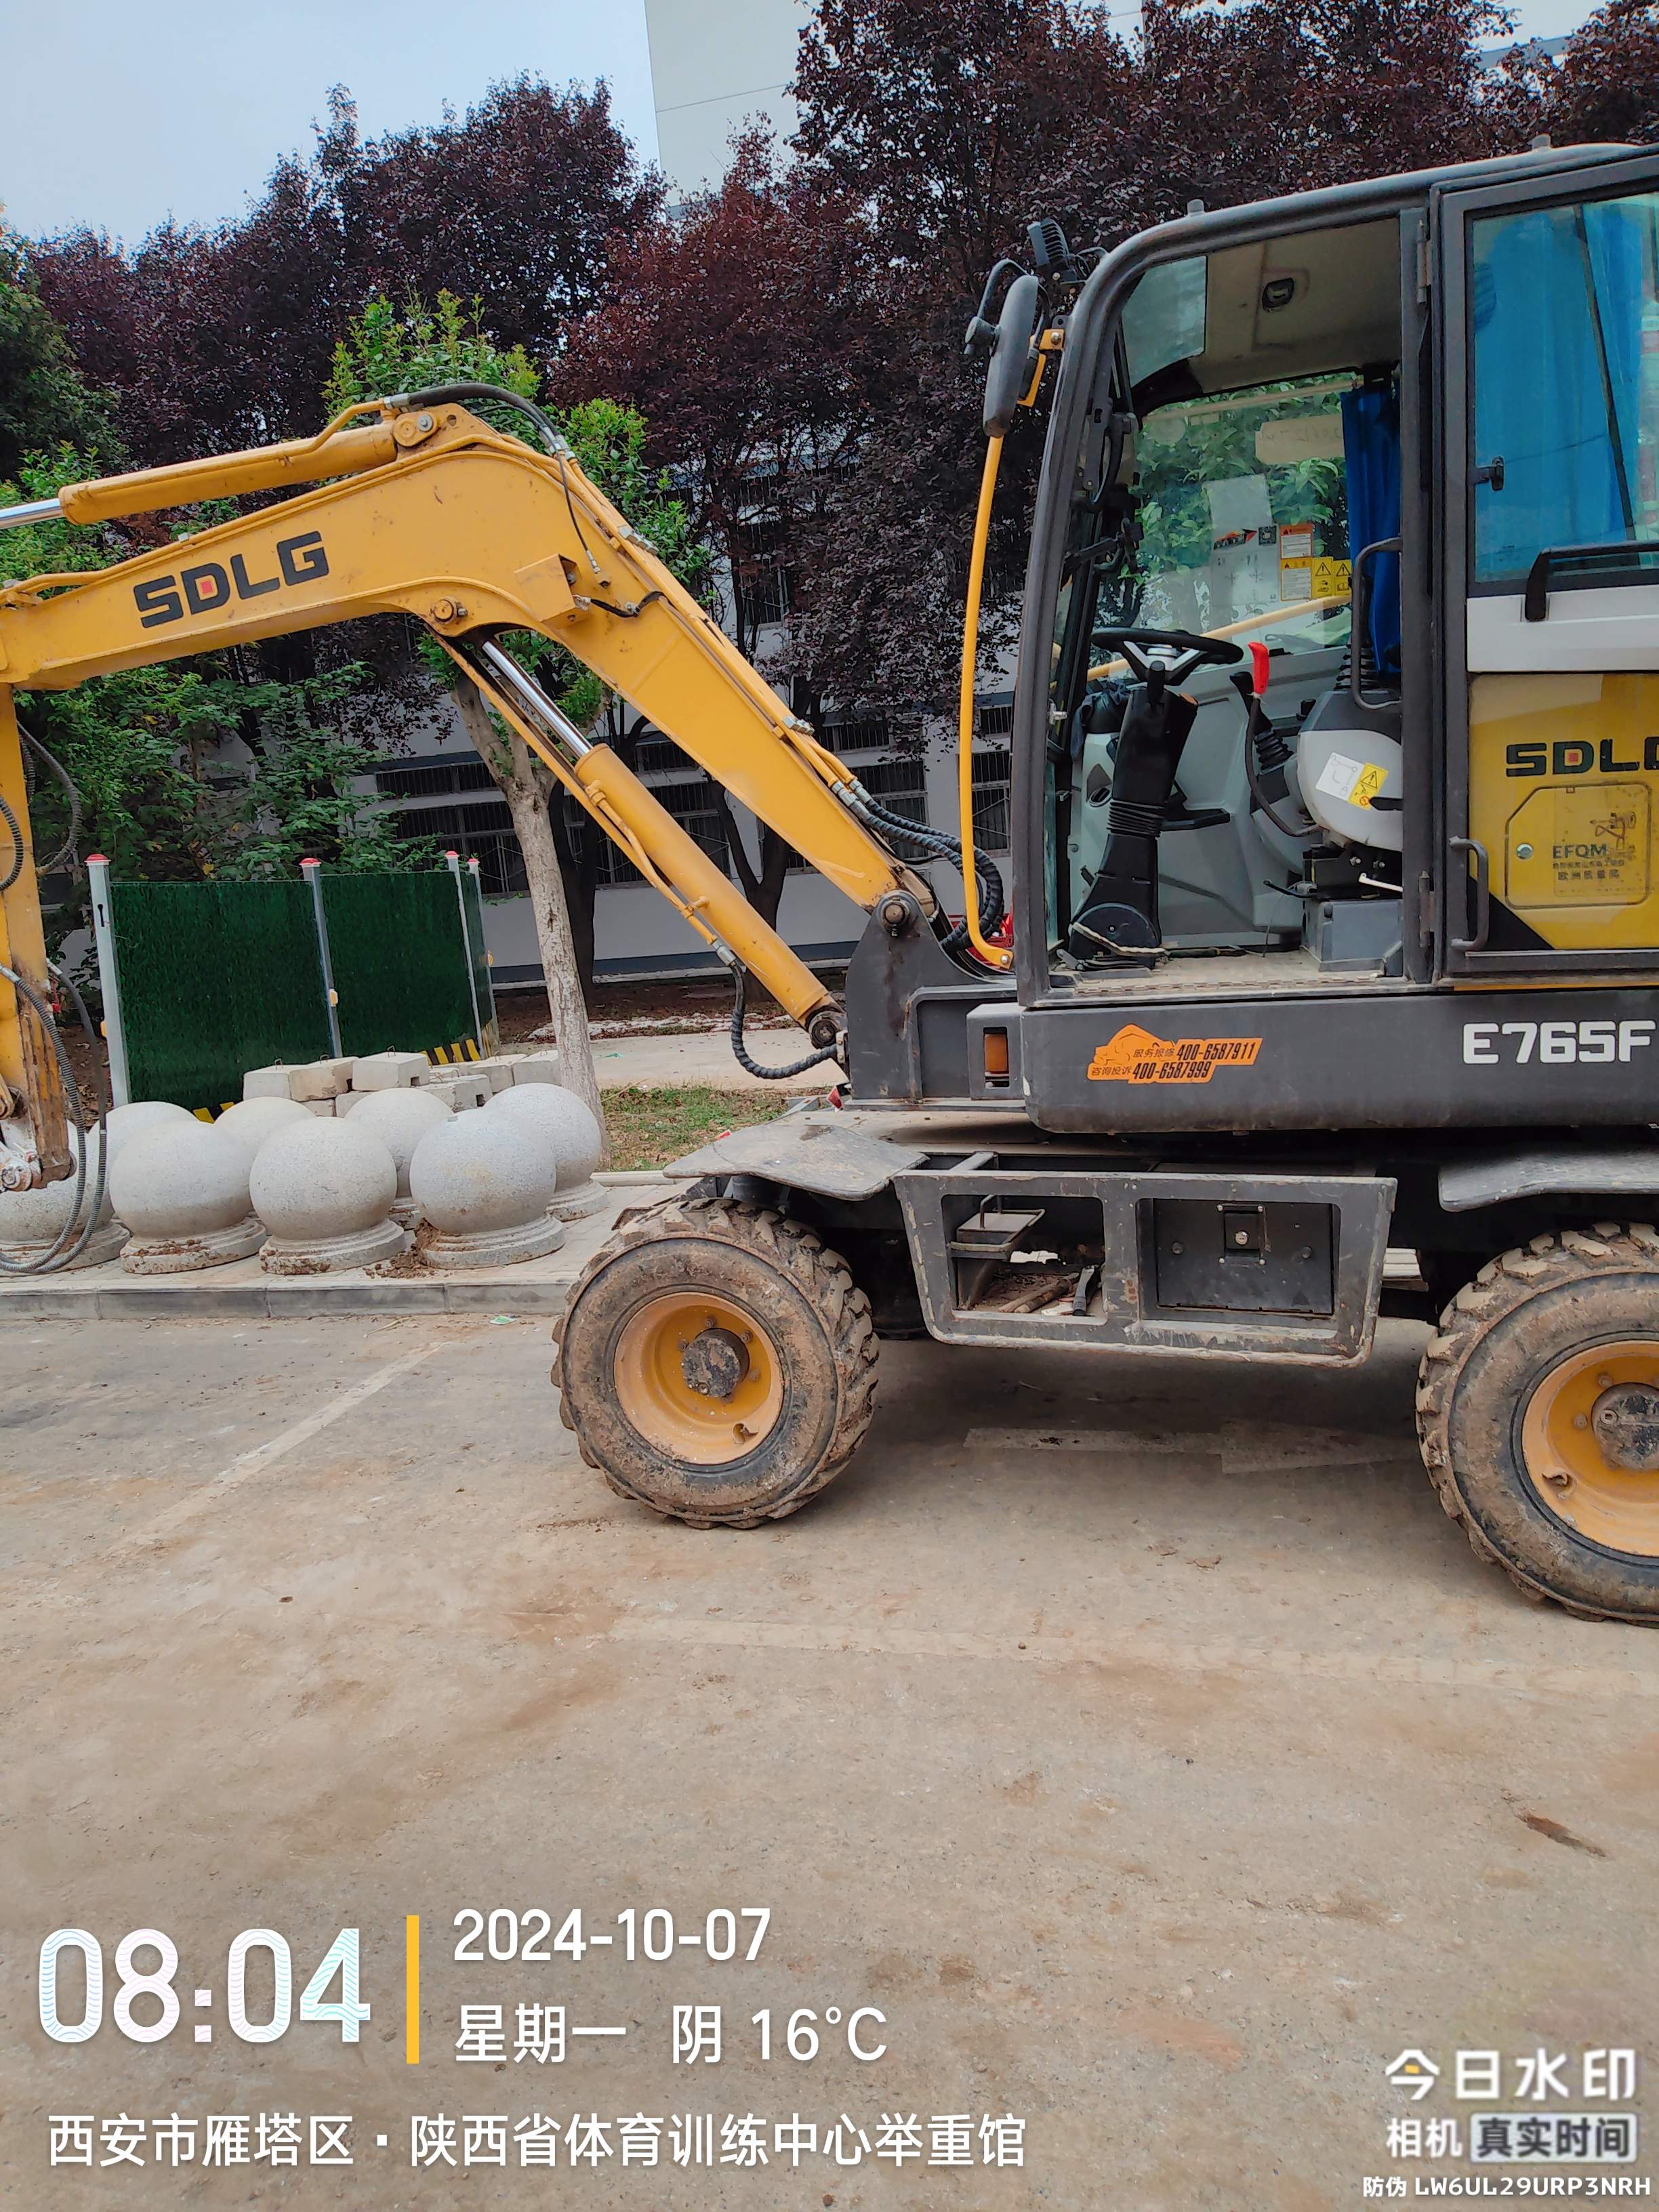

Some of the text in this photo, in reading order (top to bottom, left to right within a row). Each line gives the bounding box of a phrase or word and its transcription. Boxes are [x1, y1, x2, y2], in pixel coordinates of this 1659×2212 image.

[134, 531, 329, 629] SDLG
[1553, 844, 1607, 859] EFQM
[1176, 1042, 1256, 1061] 400-6587911
[1463, 1020, 1656, 1065] E765F
[1132, 1061, 1212, 1080] 400-6587999
